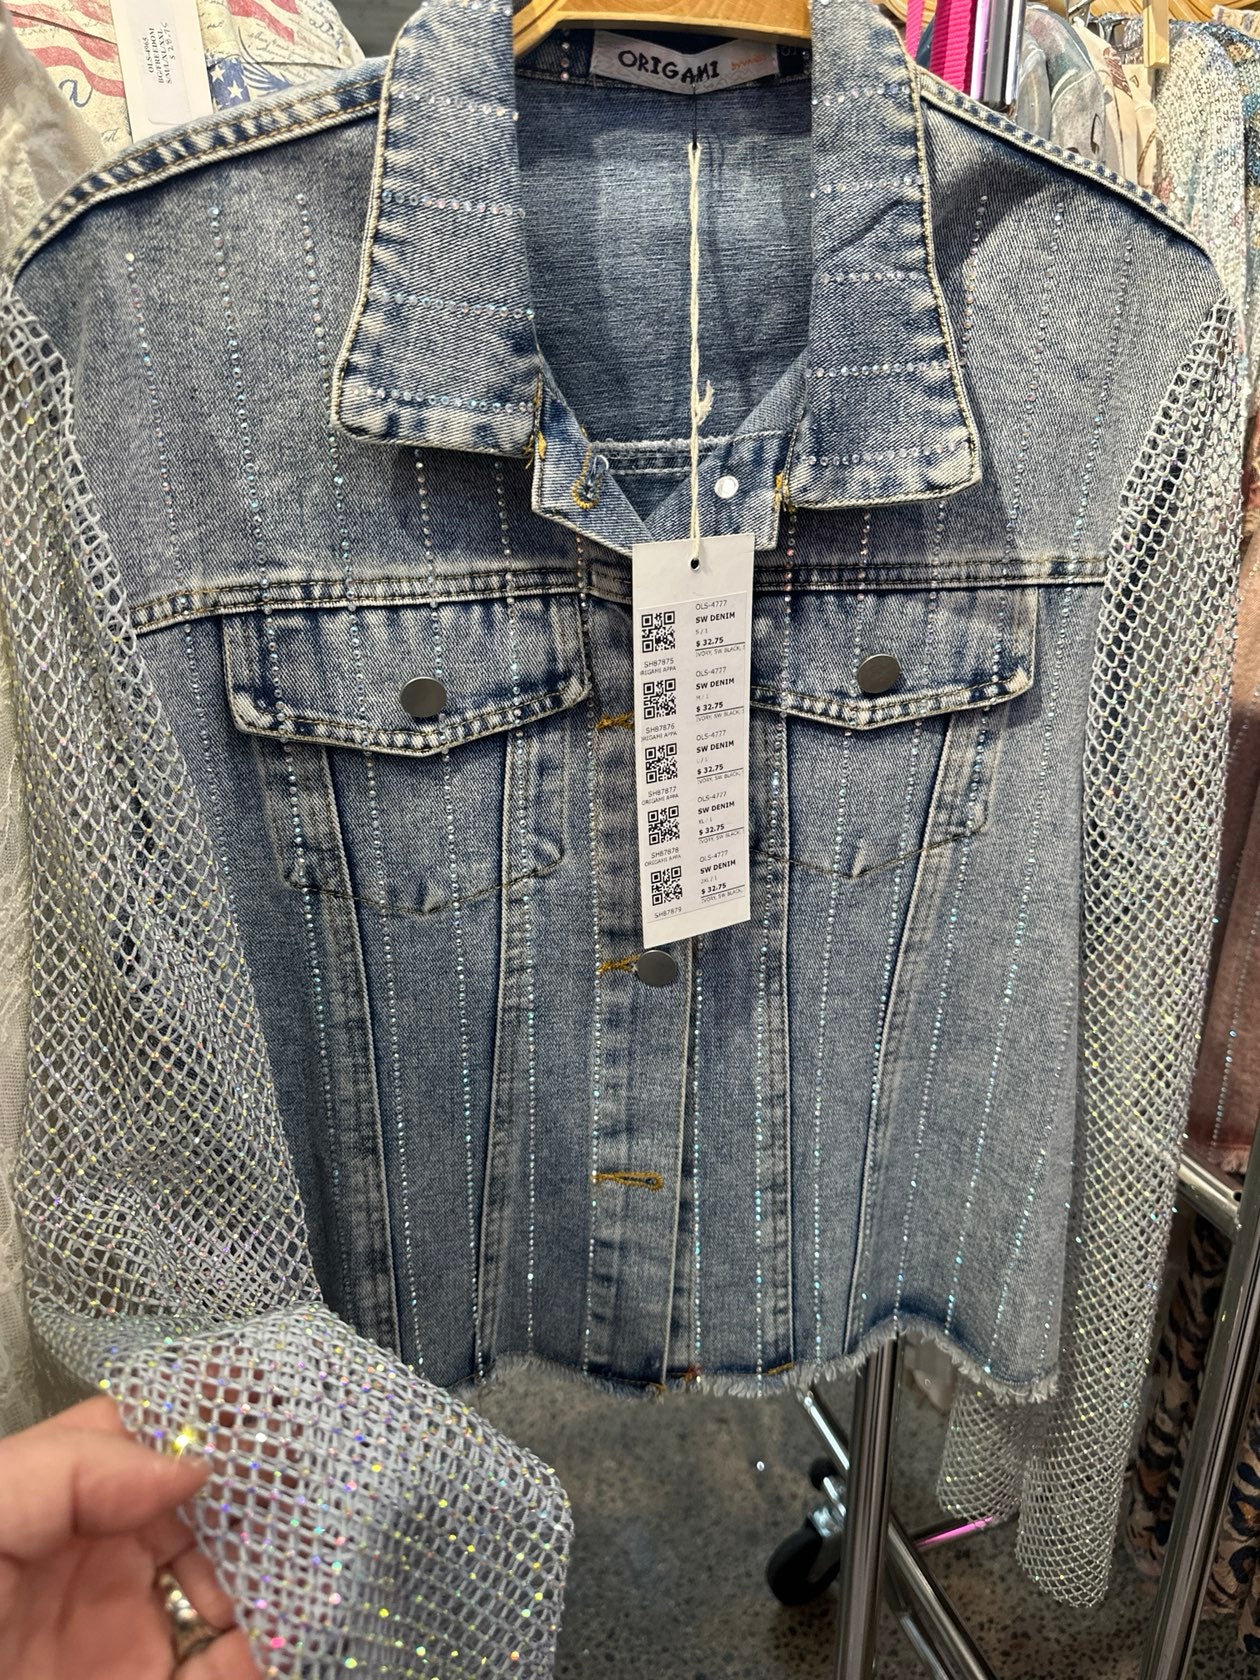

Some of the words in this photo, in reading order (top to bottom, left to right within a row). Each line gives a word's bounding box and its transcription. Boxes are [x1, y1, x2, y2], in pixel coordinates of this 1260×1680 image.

[618, 50, 720, 84] ORIGAMI
[695, 600, 727, 610] OLS-4777
[695, 616, 708, 624] SW
[710, 612, 735, 621] DENIM
[703, 637, 724, 646] 32.75
[695, 667, 727, 677] OLS-4777
[710, 678, 735, 688] DENIM
[703, 702, 723, 711] 32.75
[696, 730, 727, 741] OLS-4777
[696, 745, 708, 753] SW
[710, 740, 734, 751] DENIM
[704, 764, 724, 774] 32.75
[697, 791, 727, 803] OLS-4777
[698, 807, 710, 815] SW
[711, 801, 735, 812] DENIM
[705, 824, 725, 834] 32.75
[700, 850, 728, 863] OLS-4777
[700, 866, 712, 875] SW
[713, 859, 736, 871] DENIM
[707, 883, 727, 893] 32.75
